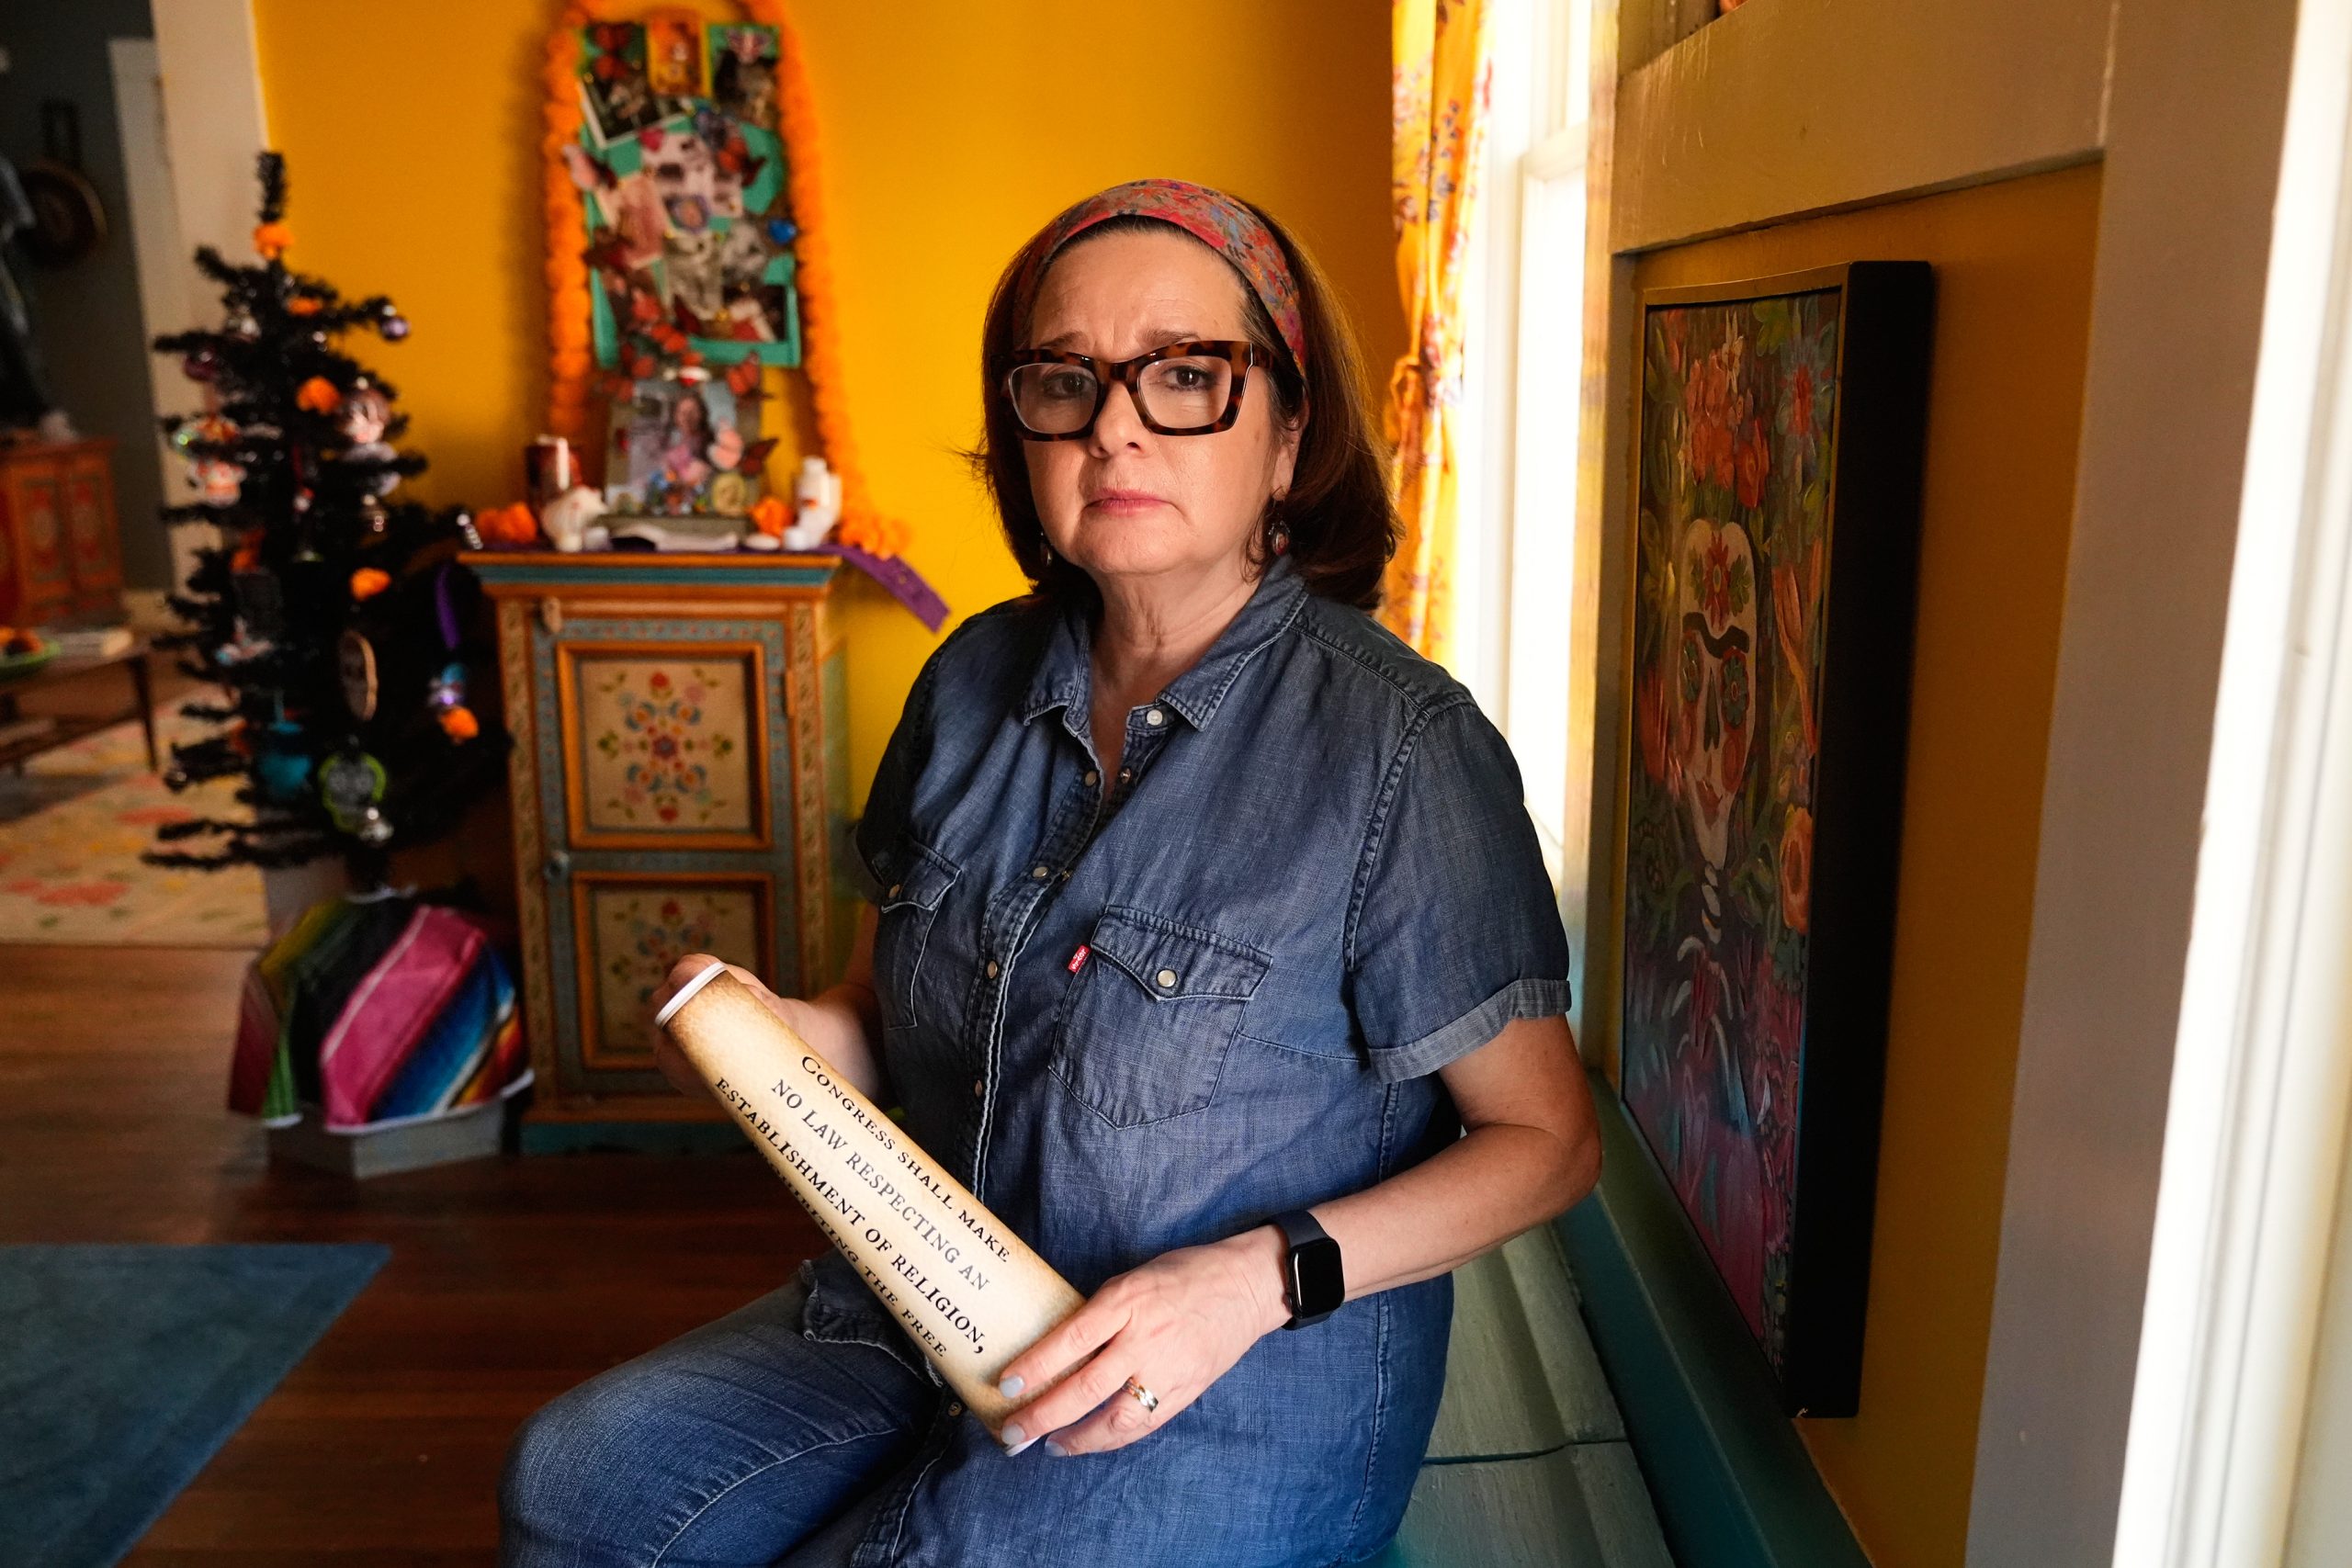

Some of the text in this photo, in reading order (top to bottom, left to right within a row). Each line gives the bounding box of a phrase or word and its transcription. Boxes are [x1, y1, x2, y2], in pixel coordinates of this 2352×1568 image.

[716, 1077, 984, 1354] ESTABLISHMENT OF RELIGION,
[772, 1079, 989, 1291] NO LAW RESPECTING AN
[802, 1056, 1010, 1262] CONGRESS SHALL MAKE
[865, 1266, 898, 1306] THE
[902, 1310, 946, 1358] FREE
